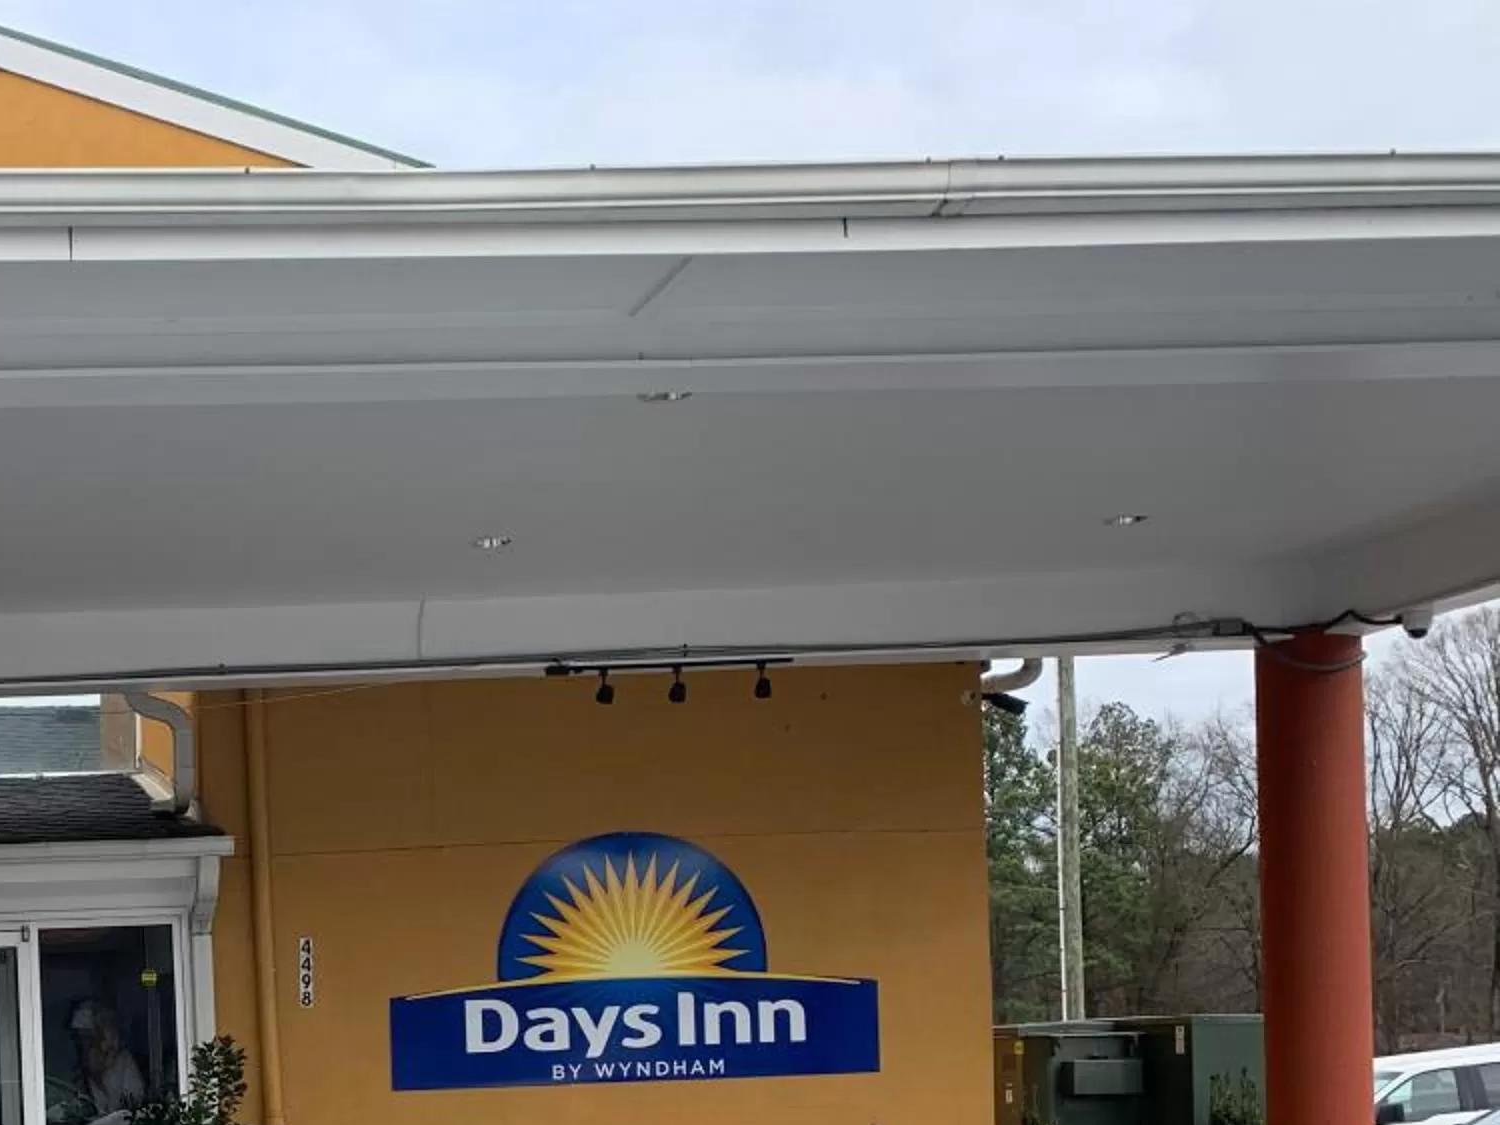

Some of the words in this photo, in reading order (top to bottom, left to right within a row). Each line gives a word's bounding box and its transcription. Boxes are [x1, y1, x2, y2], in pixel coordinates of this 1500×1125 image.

[301, 939, 312, 1007] 4498
[464, 999, 662, 1059] Days
[677, 991, 807, 1046] Inn
[552, 1063, 582, 1080] BY
[595, 1058, 725, 1079] WYNDHAM
